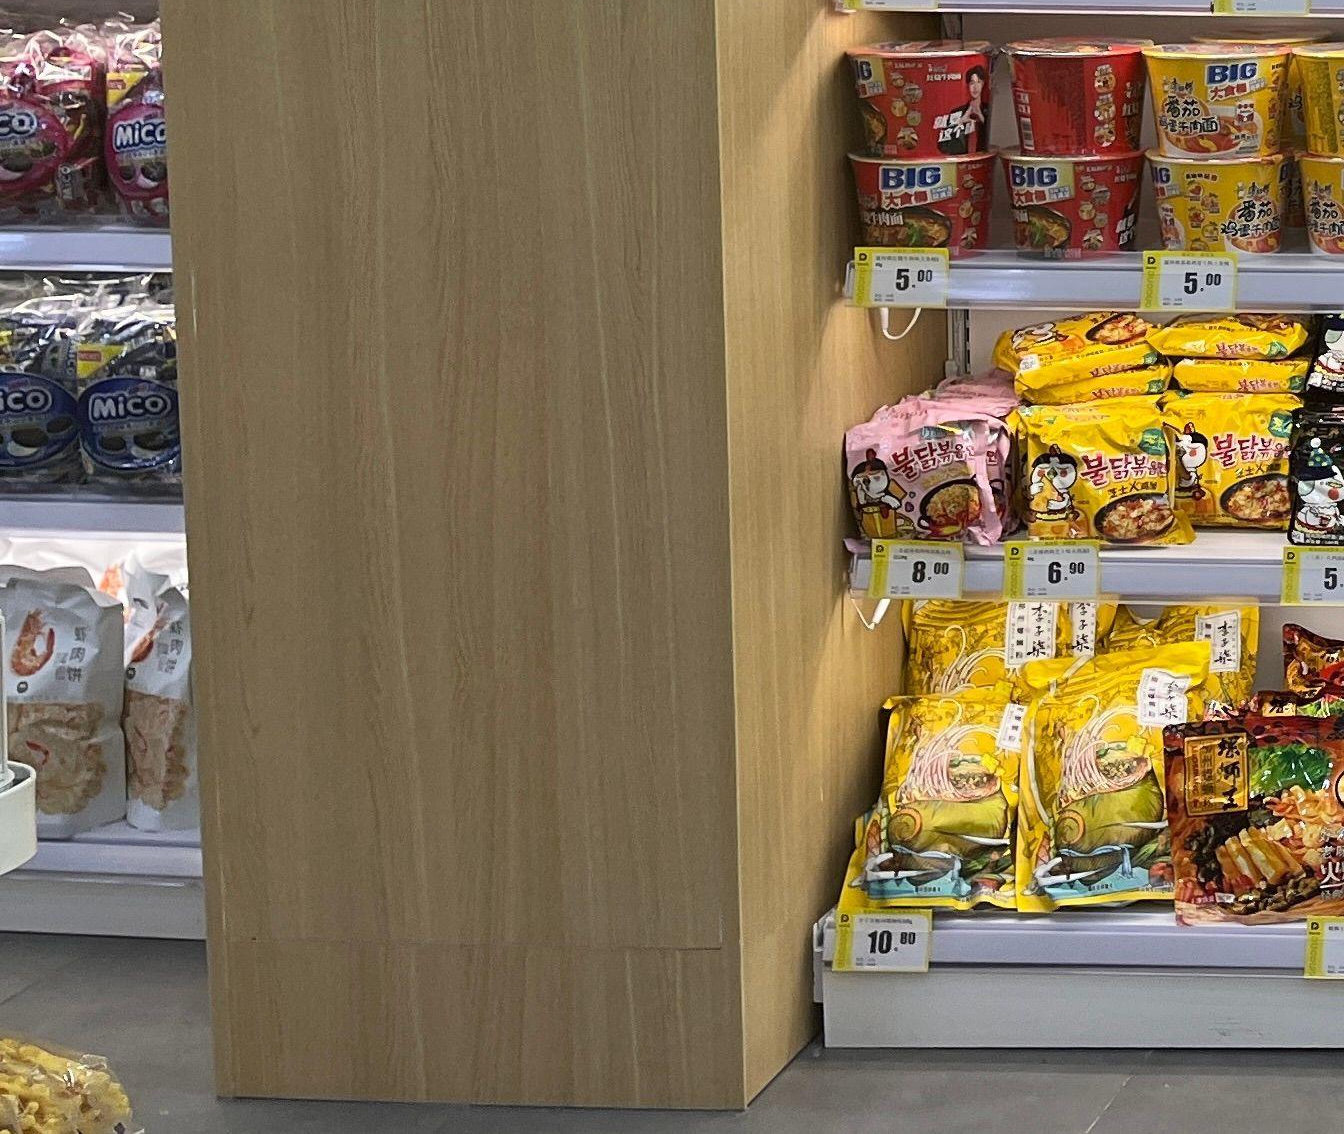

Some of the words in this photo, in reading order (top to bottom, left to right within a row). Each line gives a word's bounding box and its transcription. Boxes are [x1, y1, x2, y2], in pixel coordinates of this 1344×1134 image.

[1207, 63, 1257, 84] BIG
[1165, 95, 1201, 117] 番茄
[881, 167, 941, 189] BIG
[1010, 165, 1058, 187] BIG
[1236, 199, 1273, 220] 番茄
[895, 268, 933, 293] 5.00
[1184, 272, 1222, 296] 5.00
[89, 394, 171, 420] Mico
[912, 562, 949, 585] 8.00
